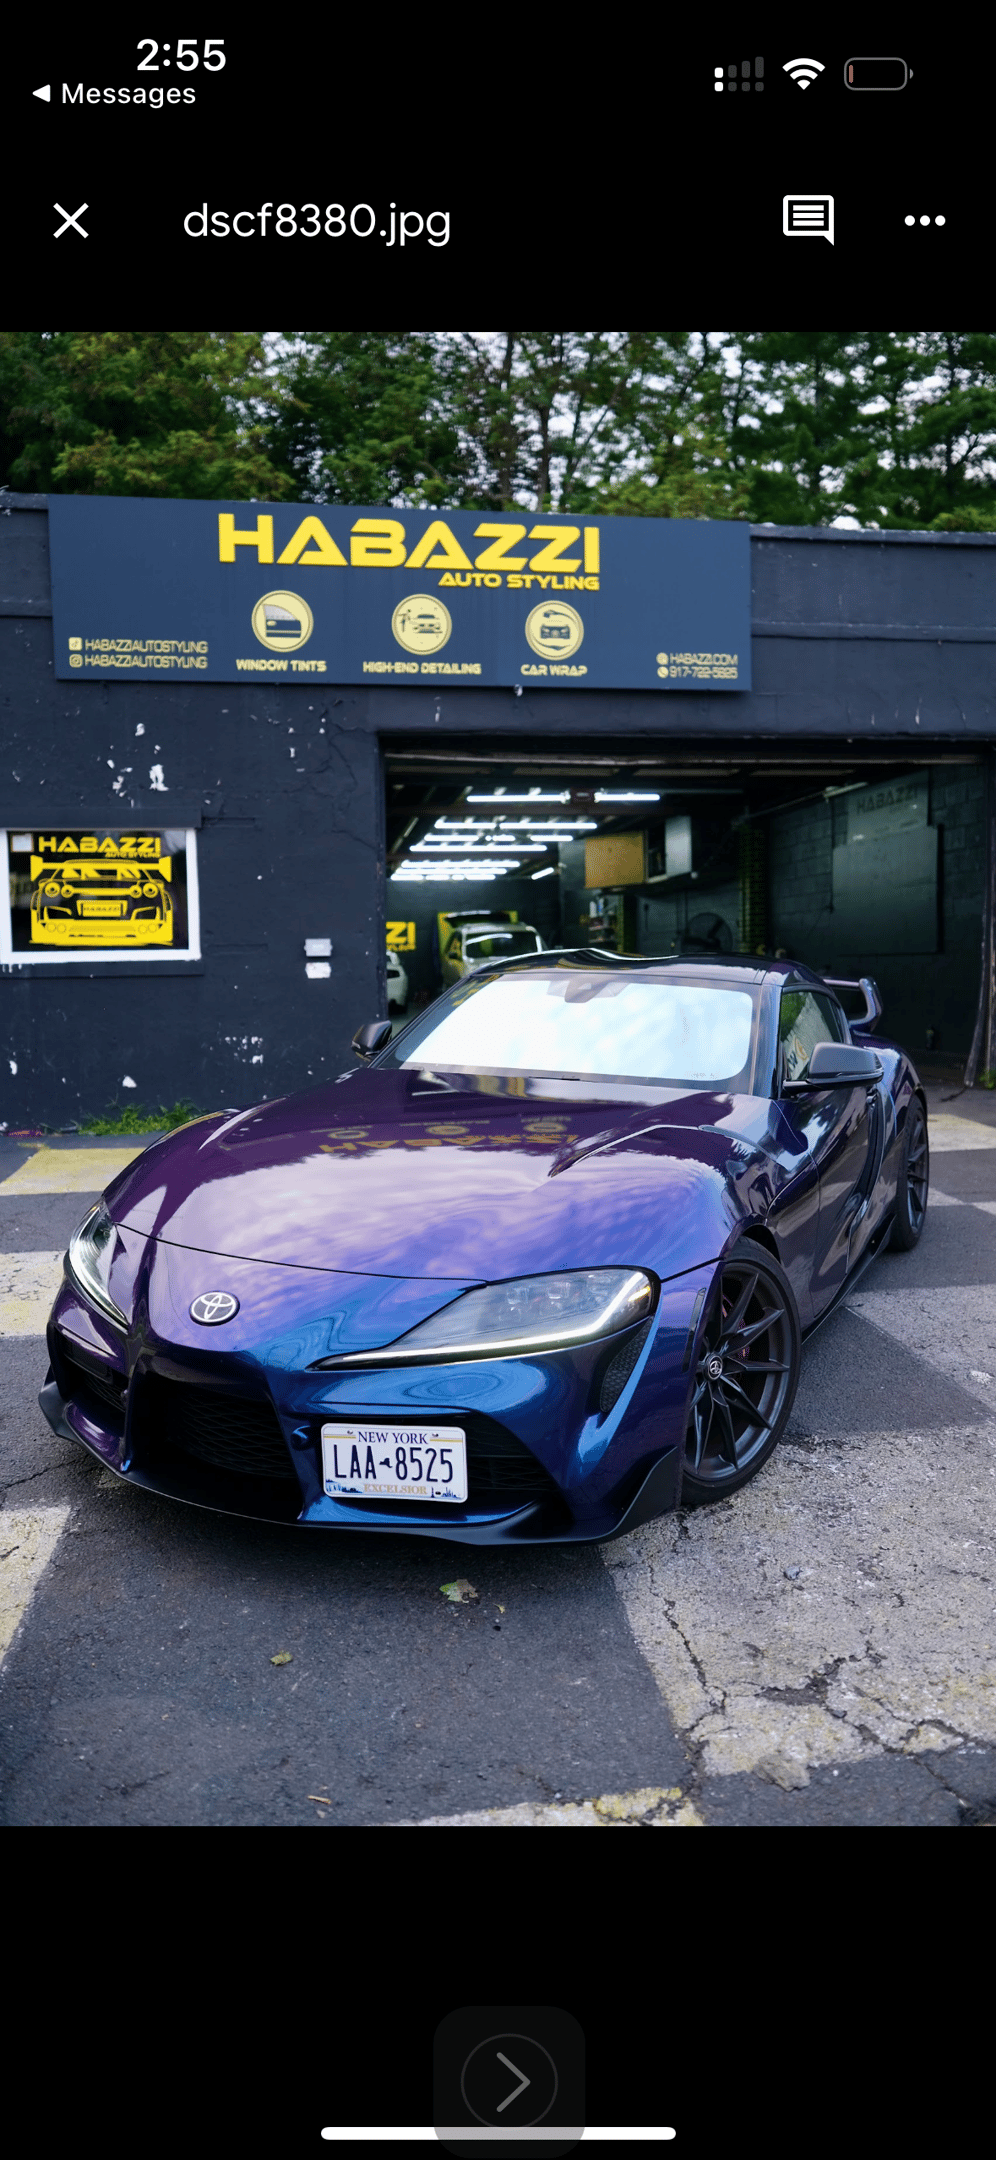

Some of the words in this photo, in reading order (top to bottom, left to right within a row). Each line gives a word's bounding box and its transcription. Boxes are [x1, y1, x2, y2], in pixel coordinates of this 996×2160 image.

[218, 512, 600, 574] HABAZZI
[438, 572, 502, 588] AUTO
[506, 573, 600, 591] STYLING
[84, 638, 208, 654] HABAZZIAUTOSTYLING
[84, 653, 208, 669] HABAZZIAUTOSTYLING
[236, 659, 288, 671] WINDOW
[290, 660, 327, 672] TINTS
[669, 652, 738, 666] HABAZZI.COM
[363, 661, 419, 673] HIGH-END
[421, 662, 482, 675] DETAILING
[520, 664, 548, 676] CAR
[549, 664, 588, 677] WRAP
[38, 836, 161, 853] HABAZZI
[357, 1431, 388, 1444] NEW
[392, 1432, 428, 1444] YORK
[364, 1483, 428, 1495] EXCELSIOR
